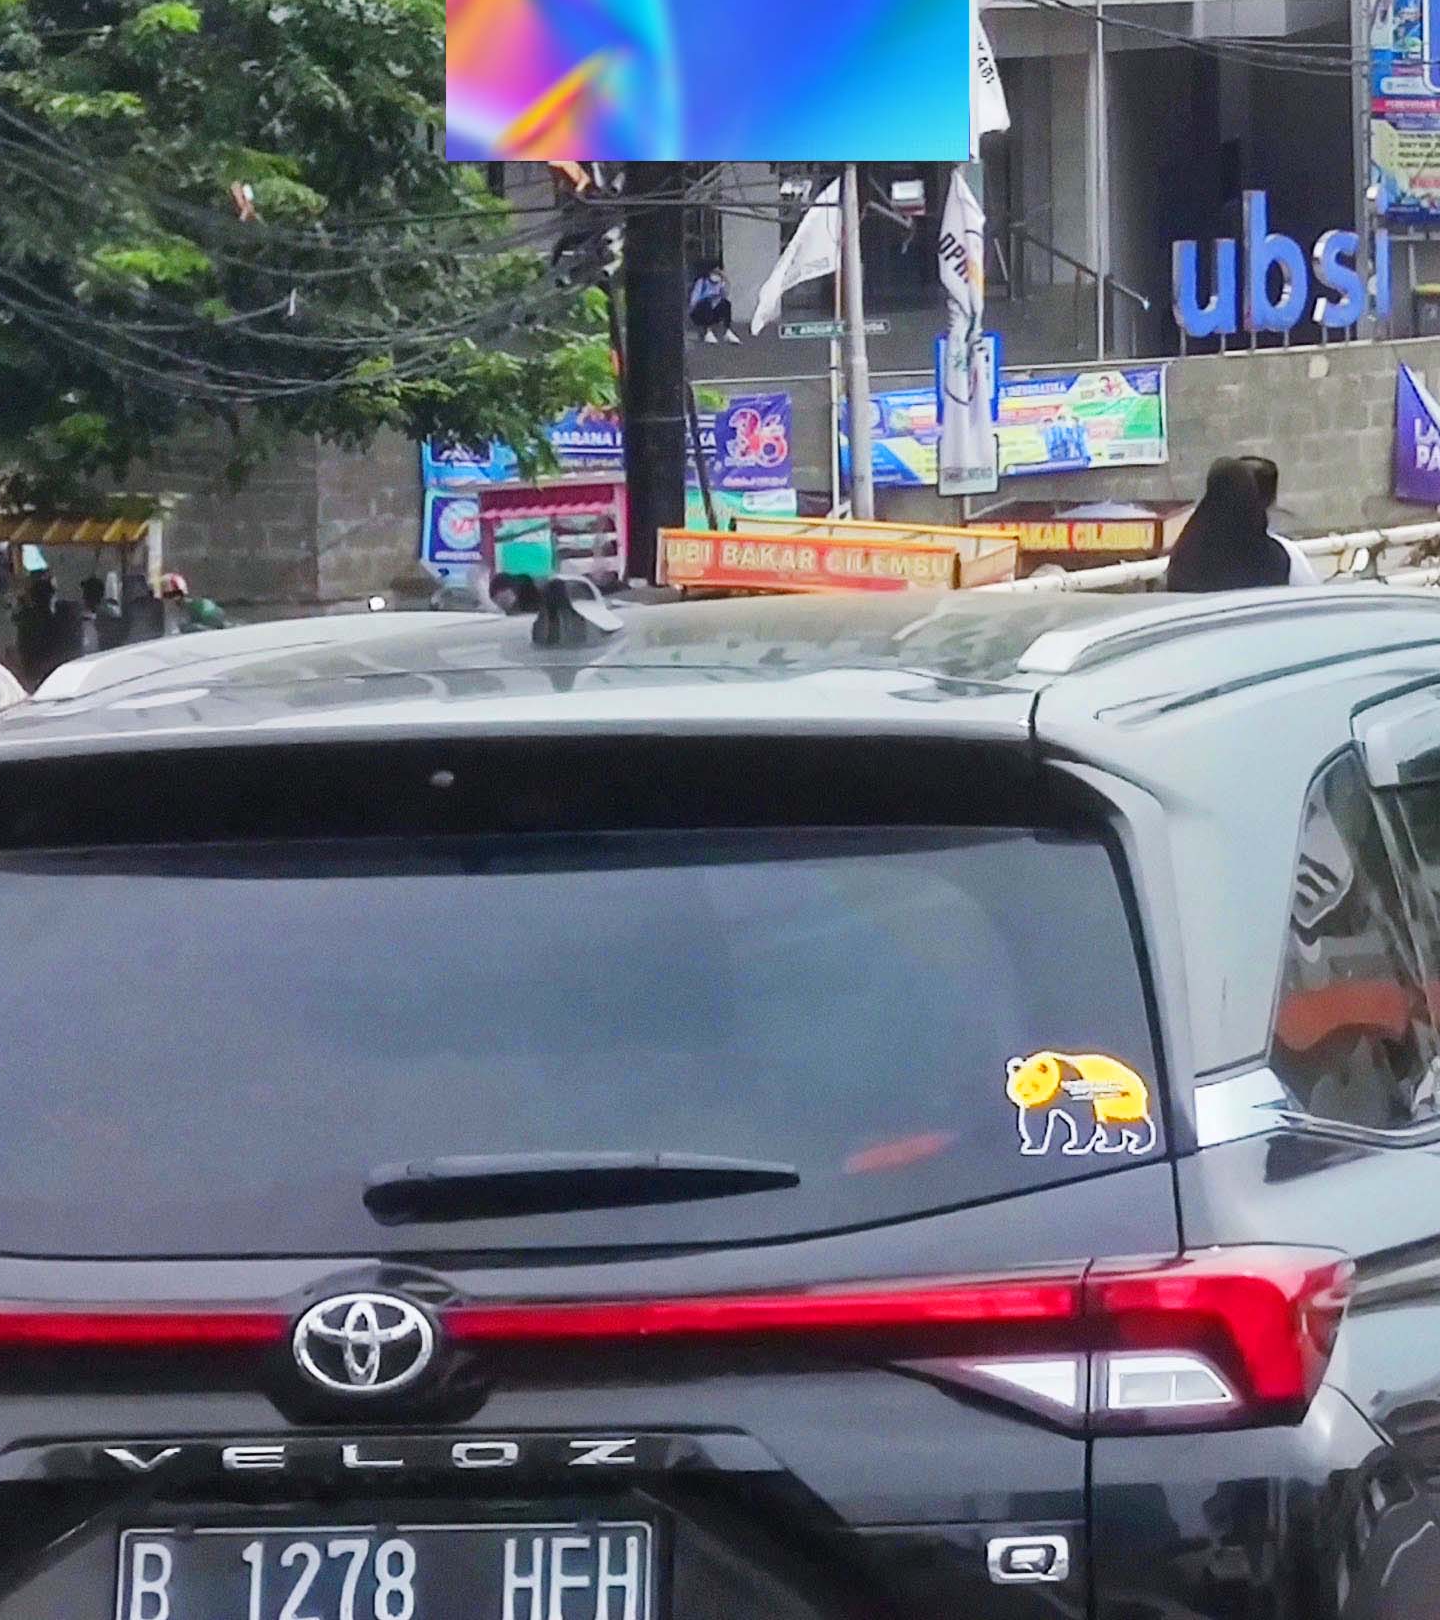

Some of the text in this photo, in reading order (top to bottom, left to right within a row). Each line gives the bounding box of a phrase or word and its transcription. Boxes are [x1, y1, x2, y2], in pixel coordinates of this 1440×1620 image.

[1172, 184, 1391, 338] ubsi
[666, 538, 712, 564] UBI
[721, 541, 817, 571] BAKAR
[104, 1438, 636, 1471] VELOZ
[130, 1542, 173, 1620] B
[242, 1538, 417, 1620] 1278
